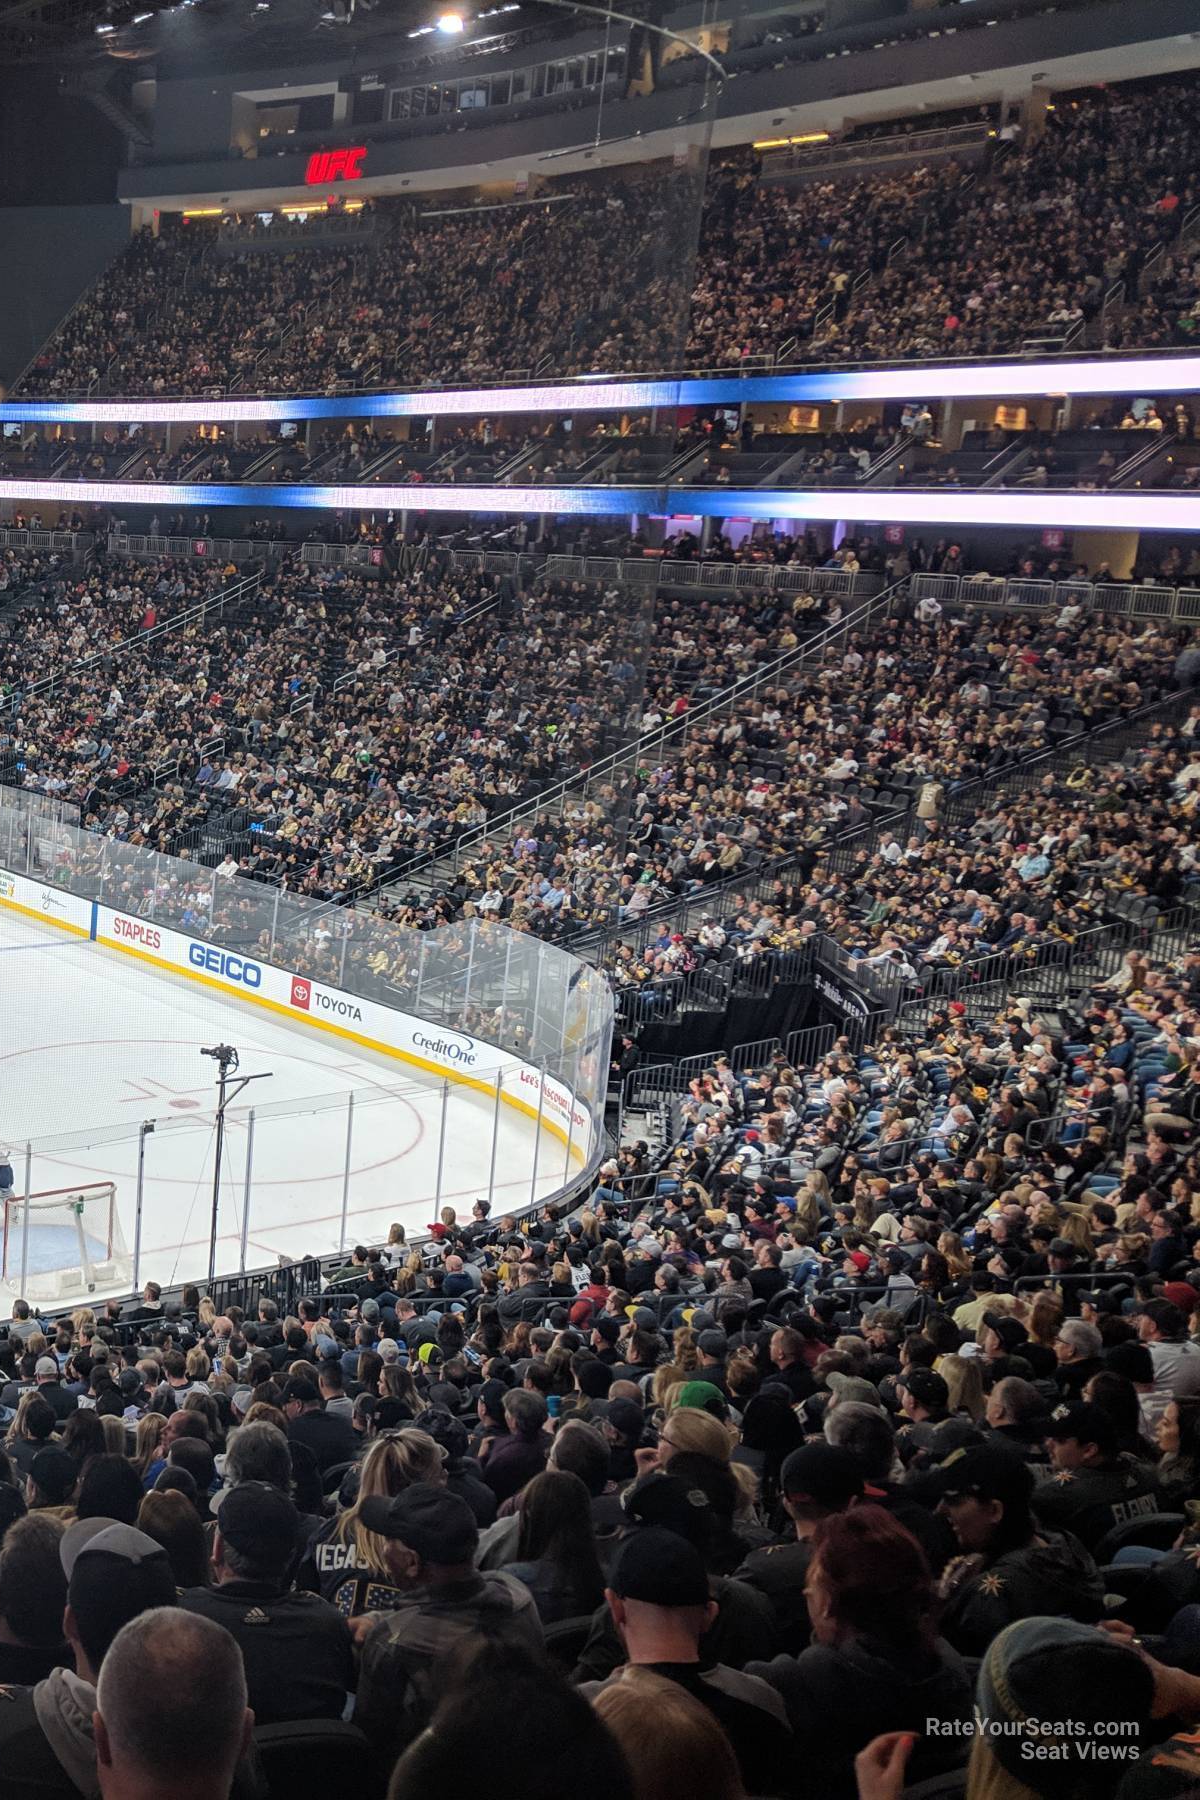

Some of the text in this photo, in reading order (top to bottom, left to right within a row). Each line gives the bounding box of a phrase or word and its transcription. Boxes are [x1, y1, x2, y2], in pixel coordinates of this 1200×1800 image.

[304, 145, 367, 185] UFC
[113, 916, 161, 950] STAPLES
[188, 943, 262, 988] GEICO
[315, 992, 362, 1022] TOYOTA
[520, 1070, 539, 1089] Lee's
